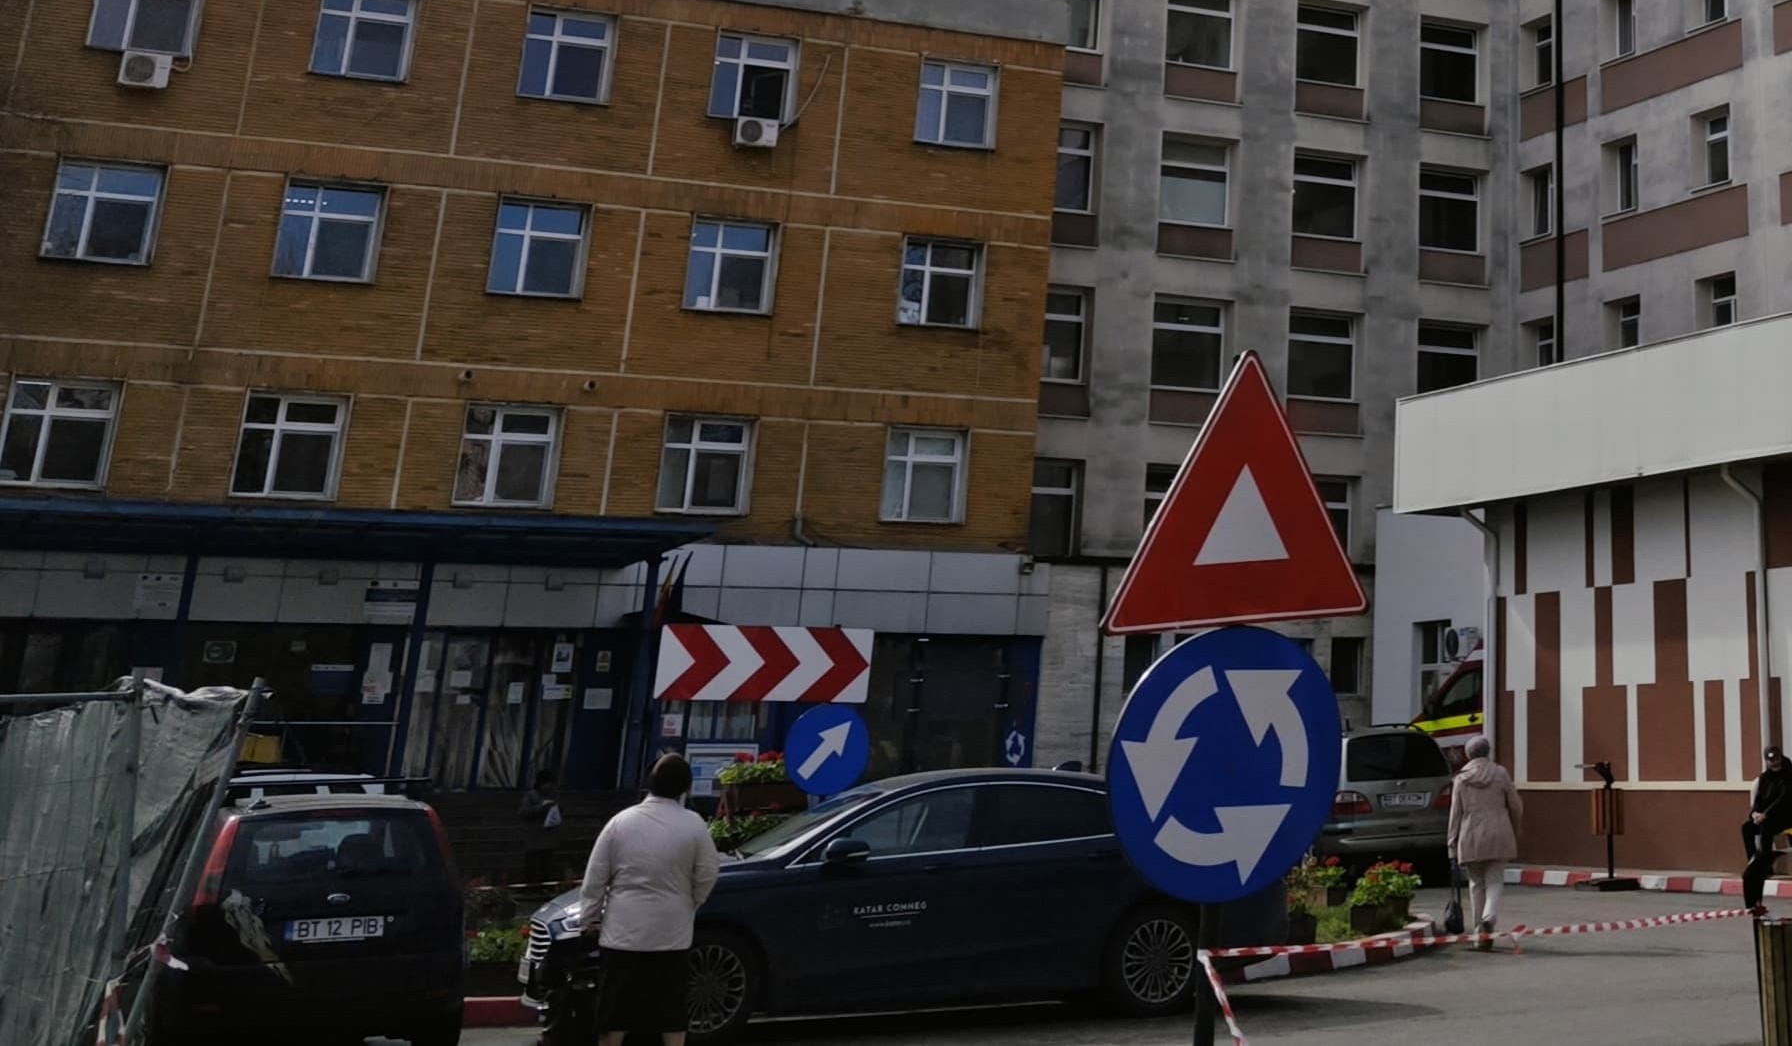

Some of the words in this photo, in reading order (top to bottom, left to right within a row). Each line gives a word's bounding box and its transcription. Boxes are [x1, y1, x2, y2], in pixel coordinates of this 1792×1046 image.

[297, 921, 321, 937] BT
[327, 920, 342, 936] 12
[351, 918, 378, 935] PIB
